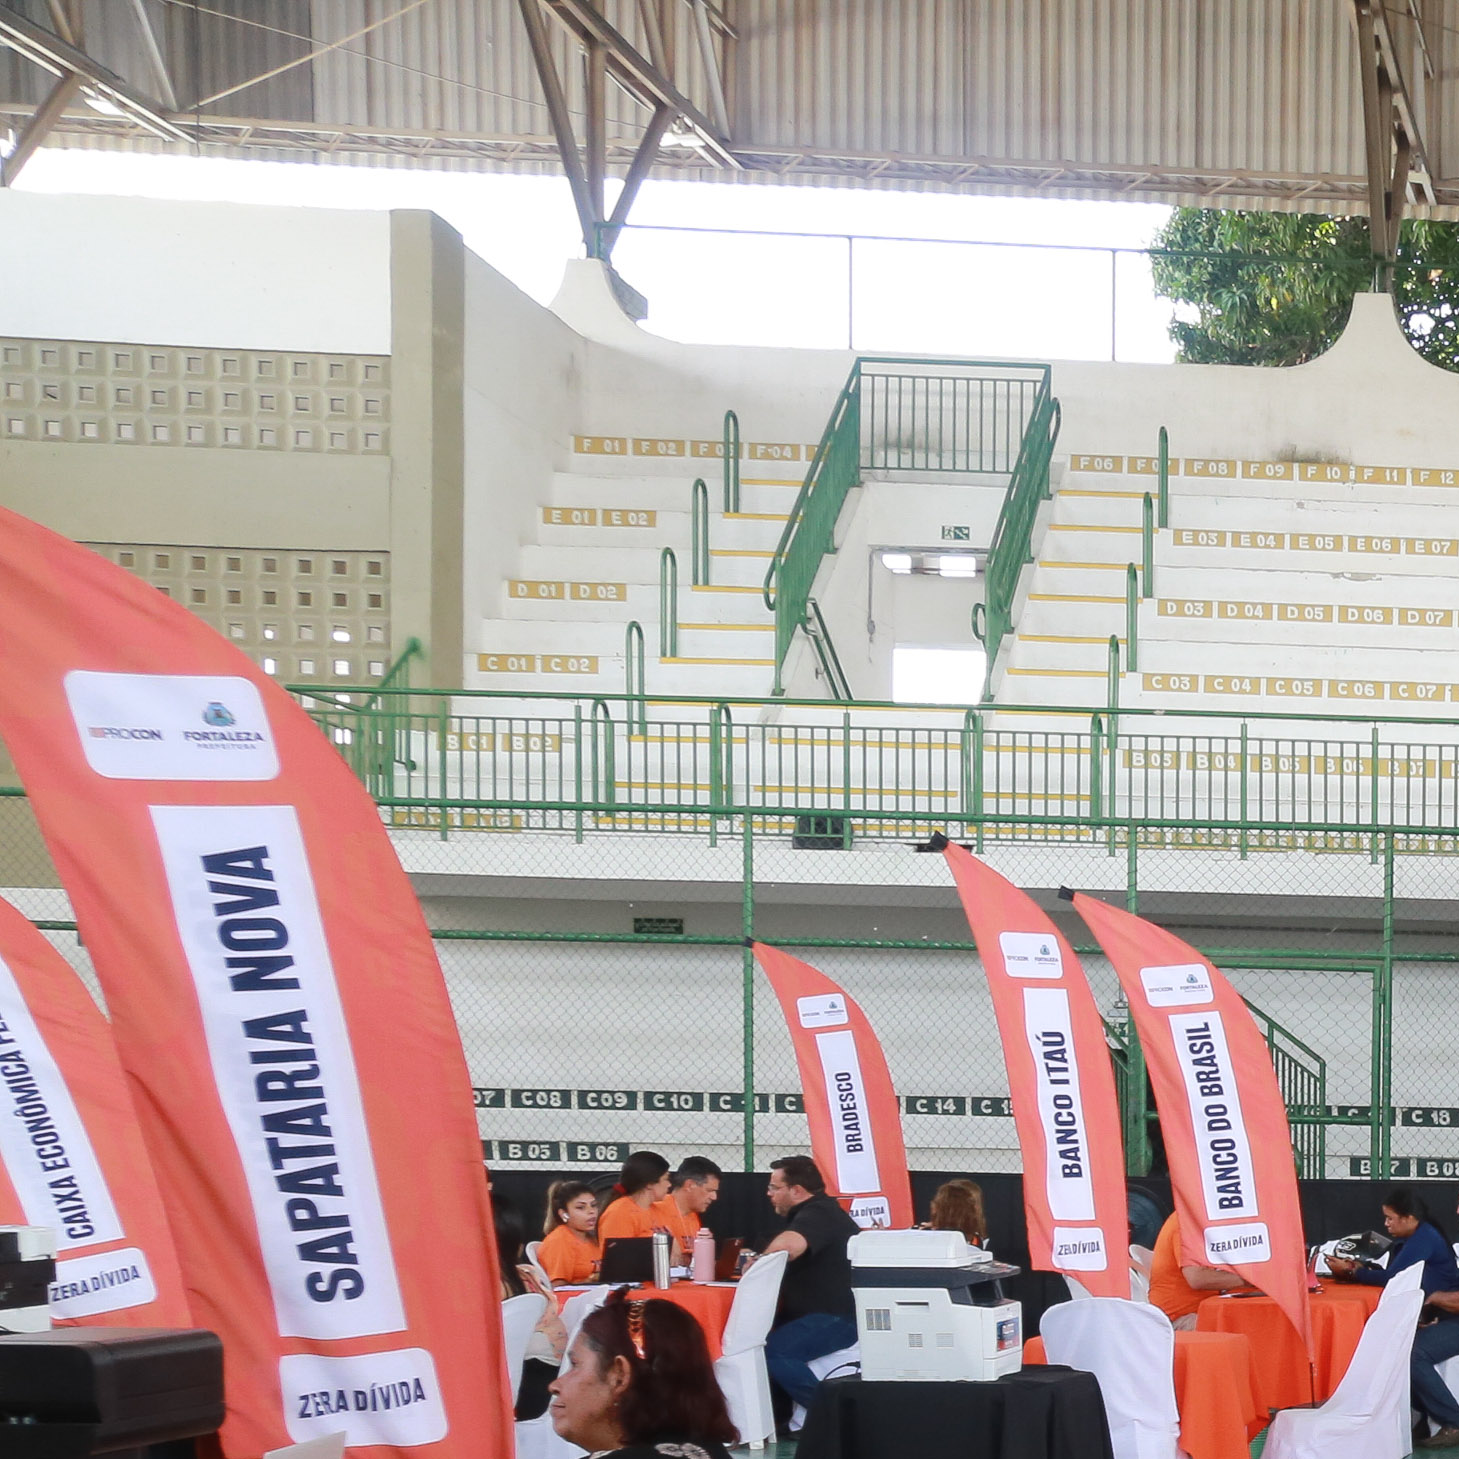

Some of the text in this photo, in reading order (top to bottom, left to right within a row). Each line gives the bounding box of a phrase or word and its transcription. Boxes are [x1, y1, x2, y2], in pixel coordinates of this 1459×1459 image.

[582, 438, 620, 453] F 01
[1249, 463, 1285, 477] F 09
[1420, 470, 1455, 485] F 12
[551, 509, 590, 524] E 01
[611, 511, 649, 526] E 02
[1414, 540, 1451, 554] E 07
[517, 583, 557, 598] D 01
[579, 584, 618, 599] D 02
[1166, 601, 1204, 616] D 03
[486, 656, 528, 671] C 01
[550, 657, 590, 672] C 02
[1151, 675, 1191, 691] C 03
[1275, 679, 1314, 696] C 05
[183, 731, 264, 741] FORTALEZA
[1185, 1022, 1226, 1097] BRASIL
[200, 846, 364, 1302] SAPATARIA NOVA
[835, 1071, 864, 1153] BRADESCO
[915, 1098, 957, 1114] C 14
[1036, 1030, 1082, 1179] BANCO ITAÚ
[1202, 1101, 1229, 1133] DO
[1411, 1109, 1451, 1126] C 18
[0, 1050, 95, 1240] CAIXA ECONÔMICA
[1205, 1137, 1243, 1209] BANCO
[1210, 1235, 1263, 1252] ZERA DÍVIDA
[51, 1265, 141, 1302] ZERA DÍVIDA
[298, 1377, 426, 1419] ZERA DÍVIDA
